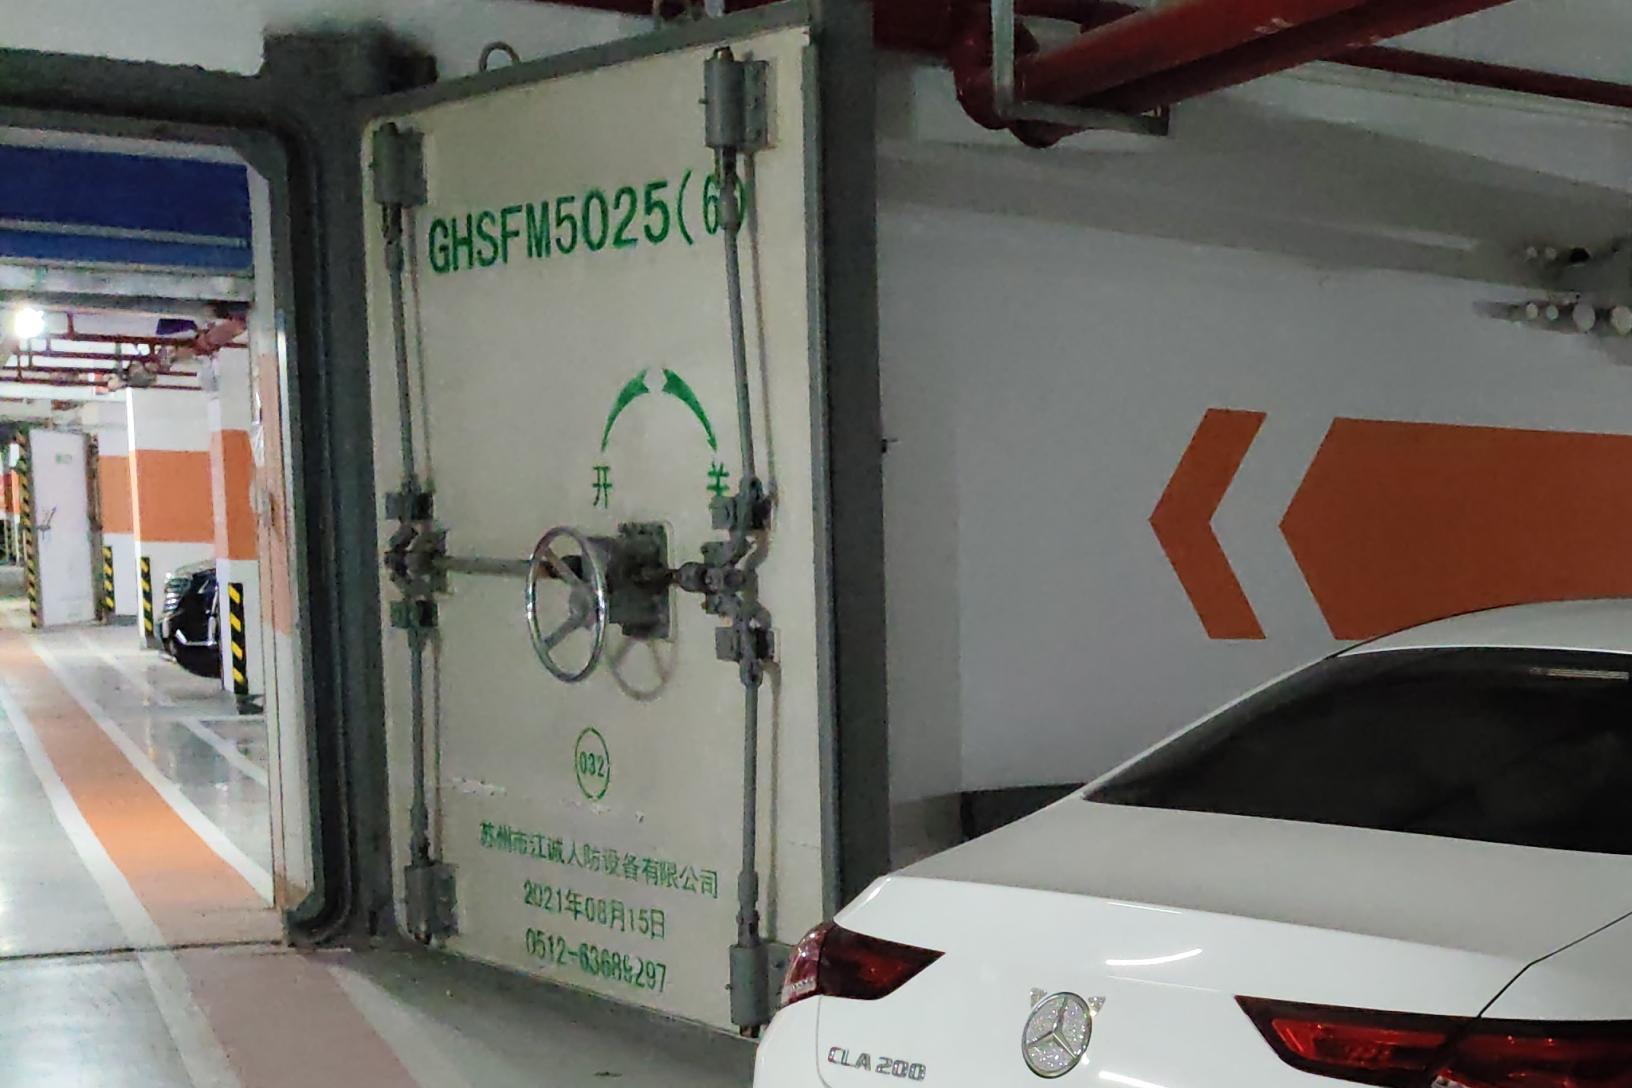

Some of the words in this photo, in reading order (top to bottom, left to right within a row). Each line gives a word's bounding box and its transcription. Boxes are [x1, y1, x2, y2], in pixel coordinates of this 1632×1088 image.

[592, 465, 612, 508] 开
[580, 751, 605, 778] 032
[827, 1046, 872, 1072] CLA
[875, 1056, 927, 1081] 200
